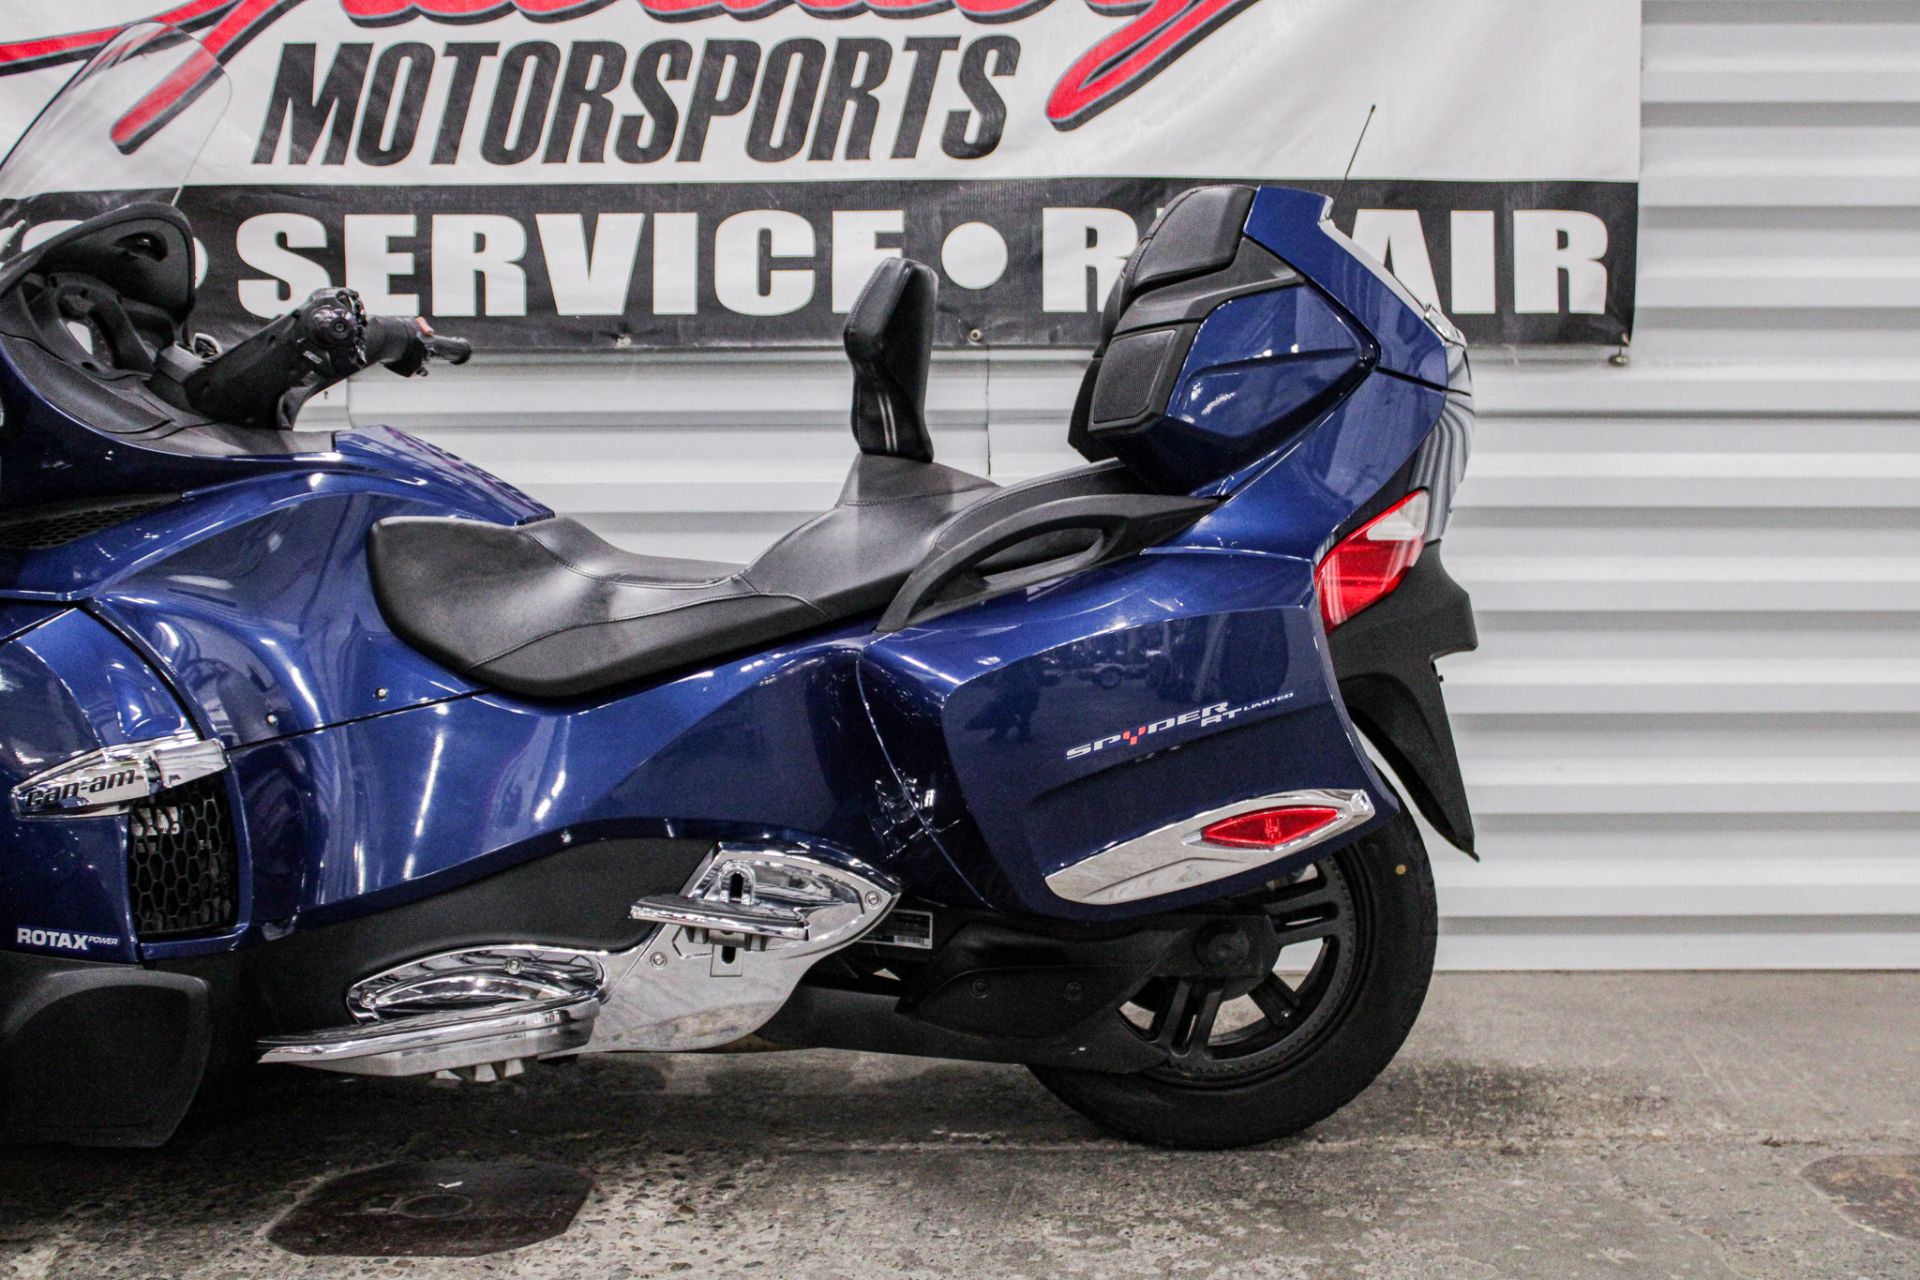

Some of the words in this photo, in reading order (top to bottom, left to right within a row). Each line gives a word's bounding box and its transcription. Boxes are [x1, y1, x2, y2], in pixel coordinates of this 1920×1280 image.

[250, 34, 1022, 166] MOTORSPORTS
[236, 210, 905, 318] SERVICE
[1042, 206, 1608, 315] RAIR
[1066, 701, 1228, 760] SPYDER
[26, 769, 136, 806] can-am
[17, 927, 88, 951] ROTAX
[88, 936, 119, 946] POWER
